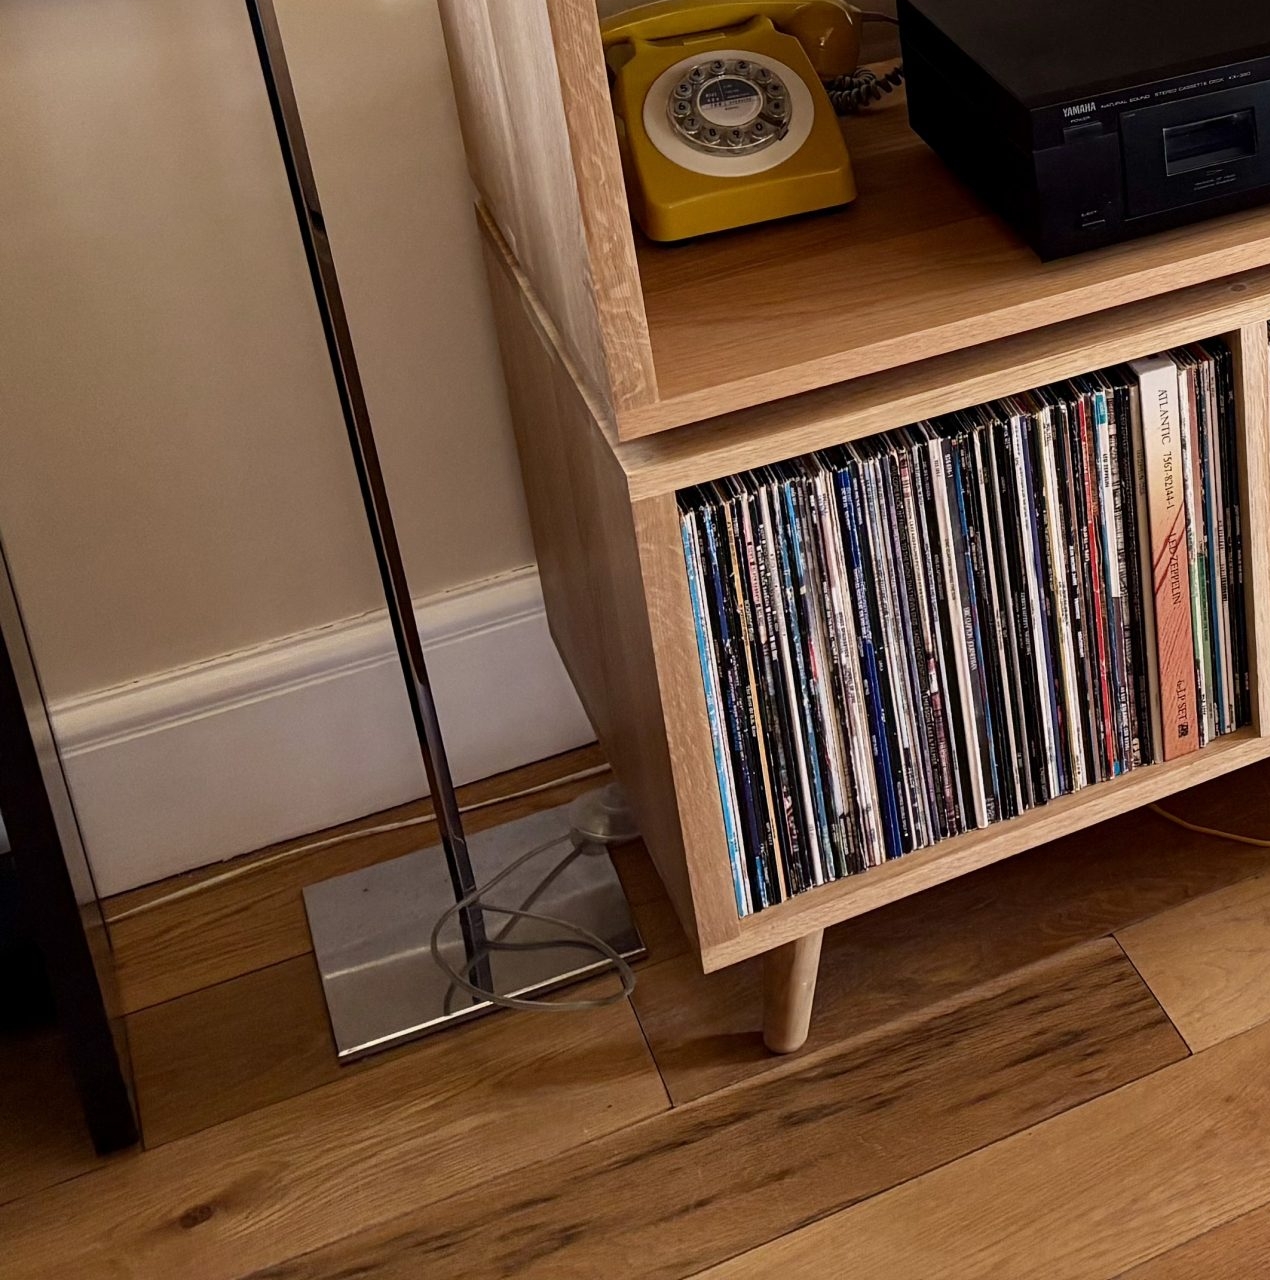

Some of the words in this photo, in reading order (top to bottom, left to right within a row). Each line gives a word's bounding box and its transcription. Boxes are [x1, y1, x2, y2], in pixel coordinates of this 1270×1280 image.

[1101, 99, 1127, 109] NATURAL
[1129, 94, 1151, 103] SOUND
[1154, 88, 1177, 97] STEREO
[1178, 81, 1207, 92] CASSETTE
[1208, 77, 1225, 86] DECK
[1062, 102, 1097, 118] YAMAHA
[1158, 389, 1171, 446] ATLANTIC
[1163, 450, 1175, 511] 7567-82144-1
[1168, 532, 1178, 554] LED
[1170, 555, 1181, 606] ZEPPELIN
[1178, 702, 1187, 721] SET
